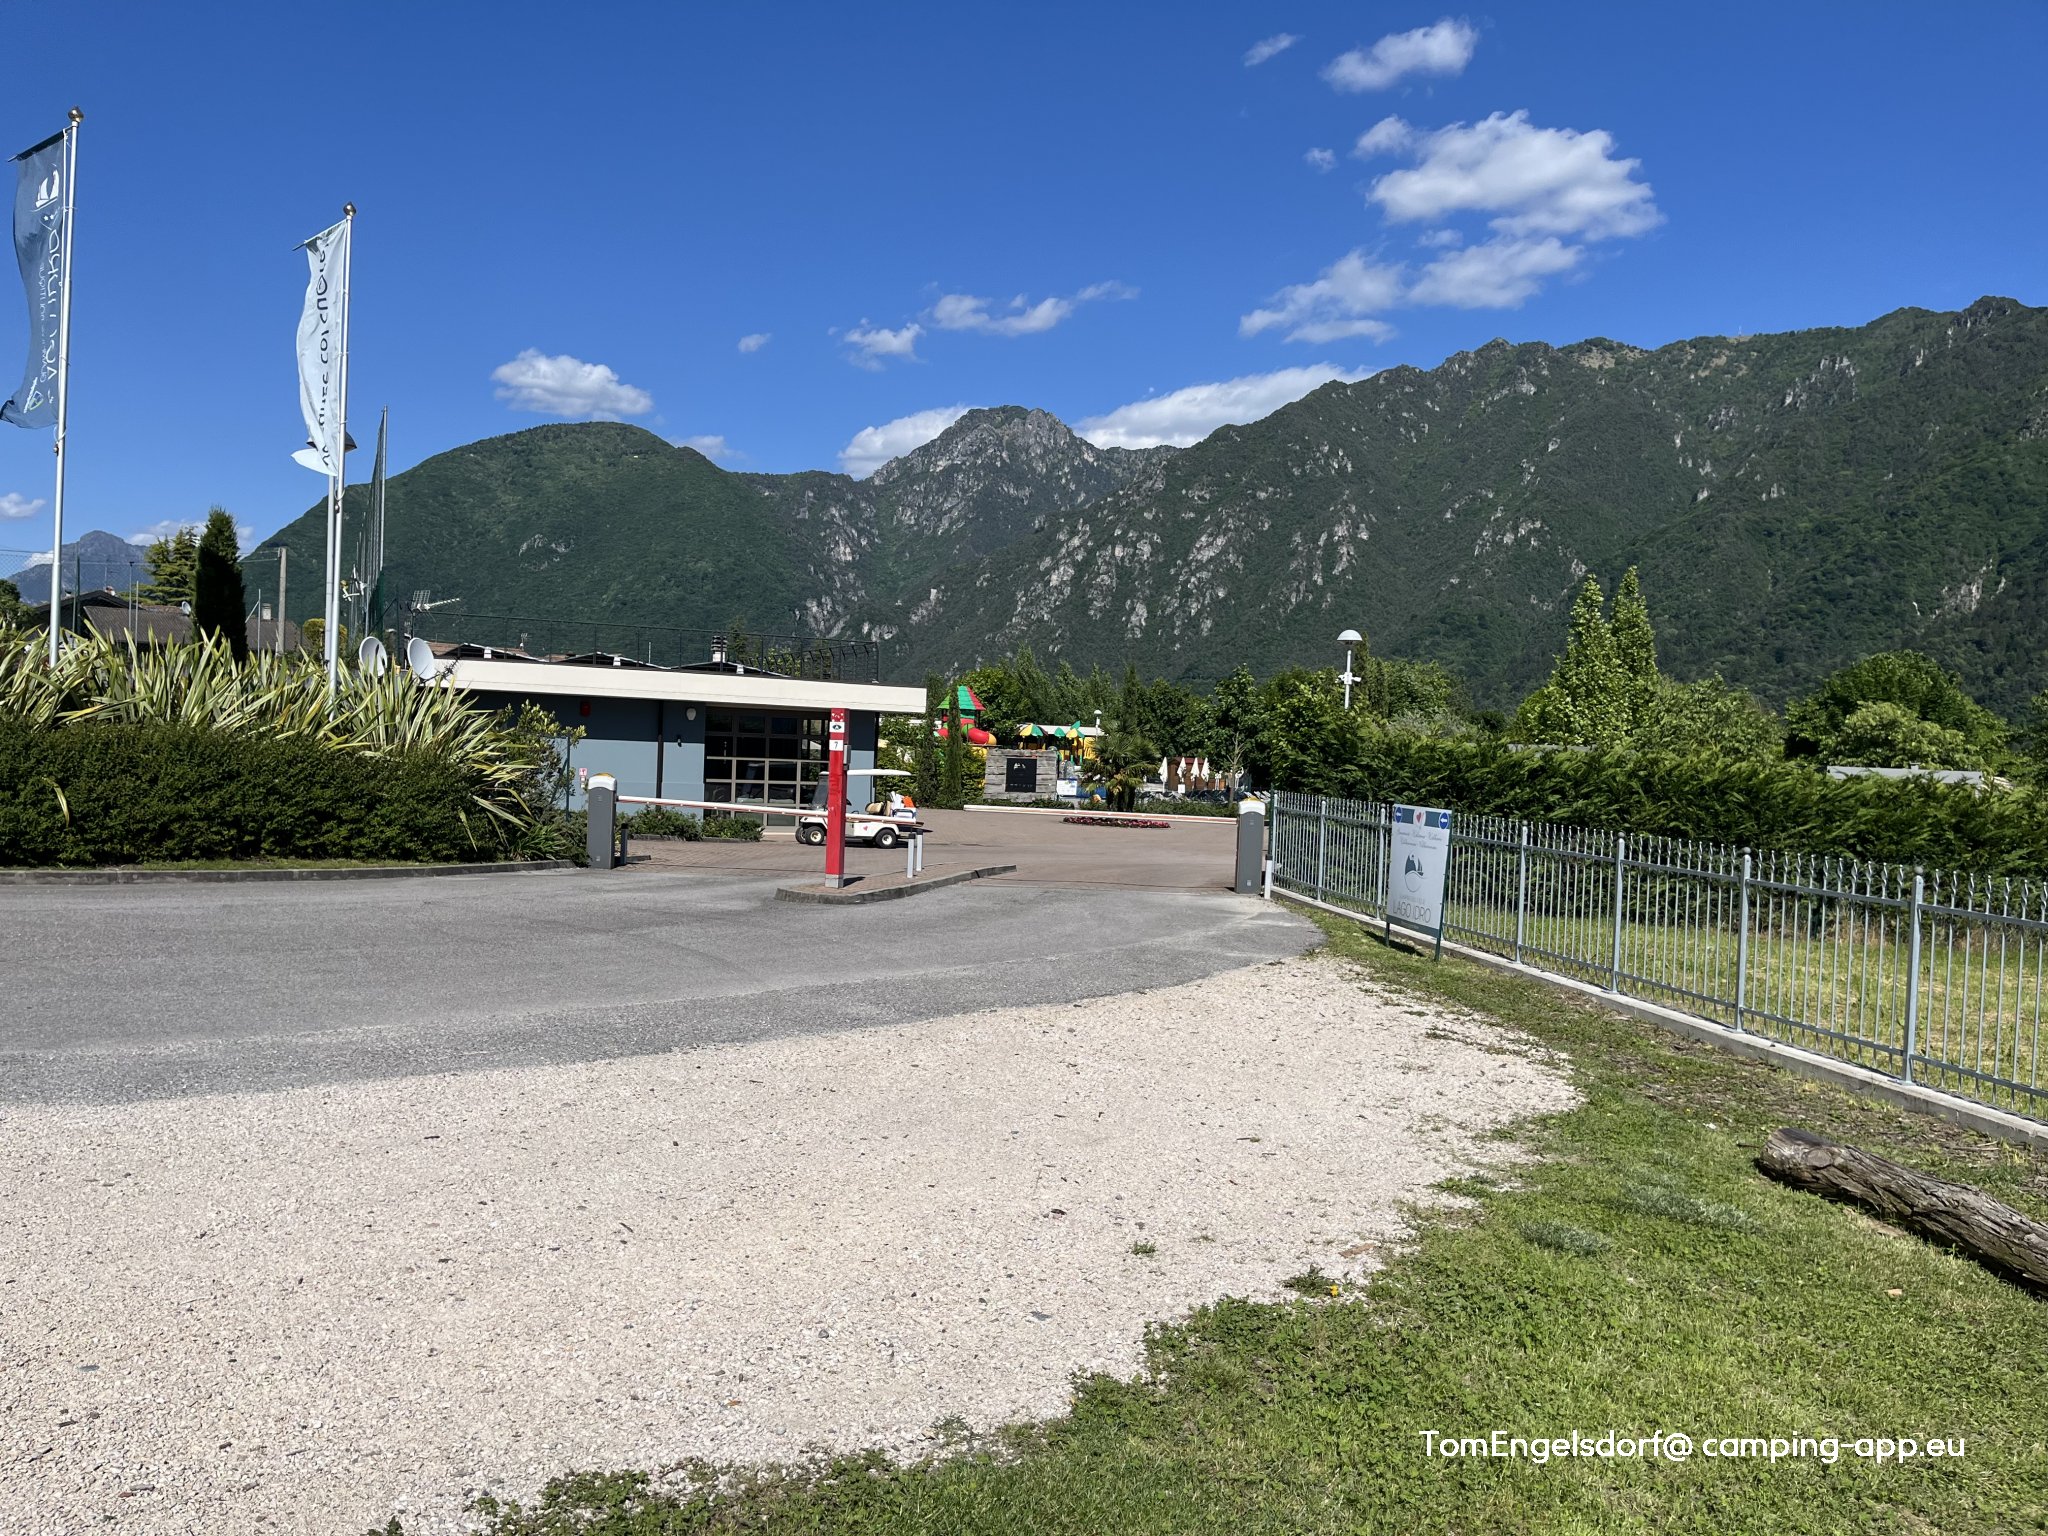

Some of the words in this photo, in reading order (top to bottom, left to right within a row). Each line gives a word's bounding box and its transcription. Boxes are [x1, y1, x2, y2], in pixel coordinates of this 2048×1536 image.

[834, 741, 839, 749] 7
[1393, 900, 1411, 918] LAGO
[1412, 903, 1431, 923] IDRO
